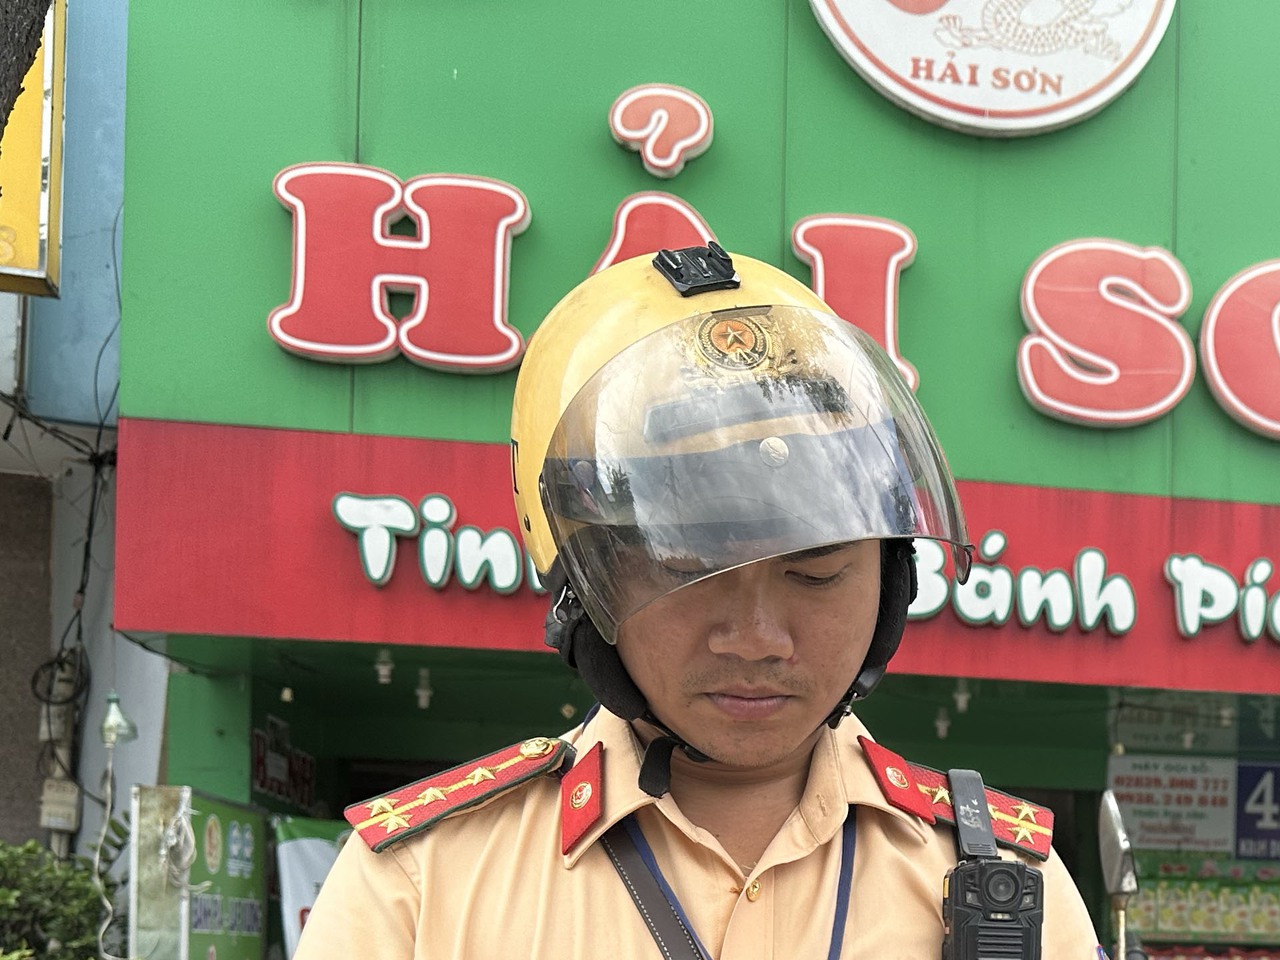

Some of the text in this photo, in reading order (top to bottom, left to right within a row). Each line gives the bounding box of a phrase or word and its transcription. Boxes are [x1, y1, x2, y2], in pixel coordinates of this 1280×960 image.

[911, 51, 1063, 96] HẢI SƠN
[331, 491, 552, 596] Tin
